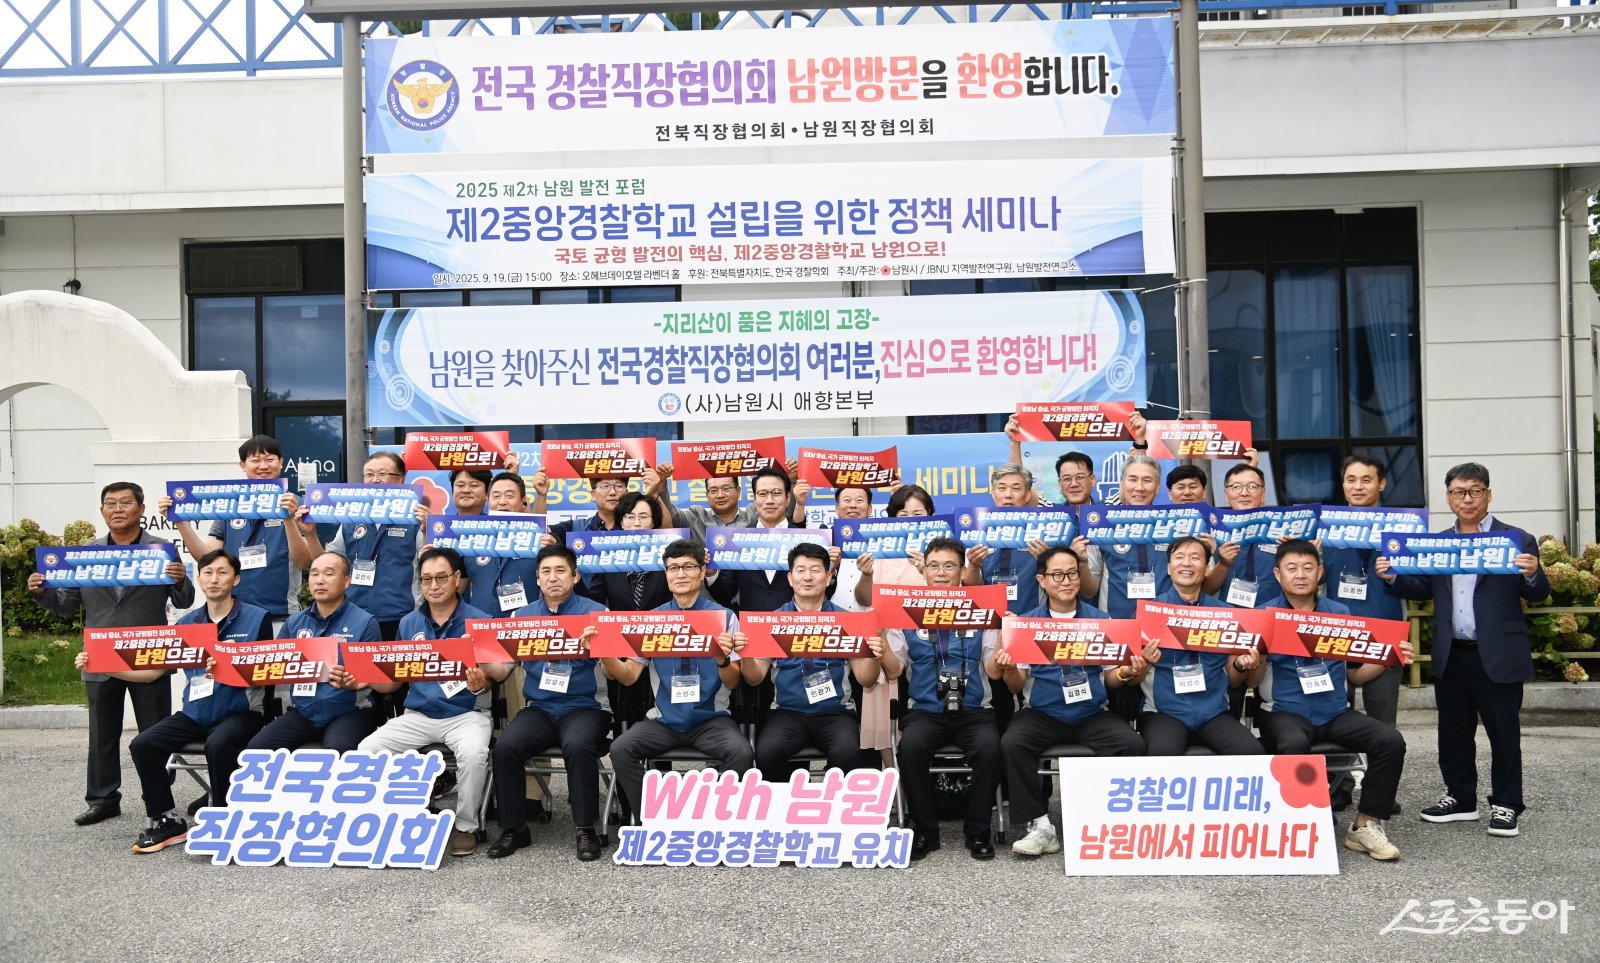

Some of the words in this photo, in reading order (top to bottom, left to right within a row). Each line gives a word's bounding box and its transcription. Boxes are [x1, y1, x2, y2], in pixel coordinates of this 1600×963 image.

[472, 66, 535, 111] 전국
[546, 59, 776, 110] 경찰직장협의회
[788, 57, 947, 102] 남원방문을
[957, 51, 1121, 99] 환영합니다.
[456, 183, 497, 197] 2025
[504, 182, 538, 197] 제2차
[544, 181, 573, 197] 남원
[580, 180, 608, 196] 발전
[616, 179, 644, 195] 포럼
[447, 203, 696, 242] 제2중앙경찰학교
[707, 201, 803, 237] 설립을
[814, 199, 879, 235] 위한
[889, 198, 951, 234] 정책
[962, 196, 1061, 232] 세미나
[555, 248, 588, 264] 국토
[594, 246, 626, 263] 균형
[633, 246, 682, 263] 발전의
[689, 245, 727, 261] 핵심,
[734, 242, 865, 260] 제2중앙경찰학교
[872, 242, 945, 258] 남원으로!
[433, 273, 453, 285] 일시:
[526, 272, 552, 281] 15:00
[560, 272, 579, 281] 장소:
[644, 270, 669, 279] 라벤더
[672, 269, 680, 279] 홀
[689, 269, 708, 279] 후원:
[711, 268, 773, 278] 전북특별자치도,
[776, 268, 792, 277] 한국
[795, 267, 828, 277] 경찰학회
[836, 264, 880, 277] 주최/주관:
[893, 265, 917, 275] 남원시
[926, 264, 950, 274] JBNU
[952, 263, 1014, 273] 지역발전연구원,
[1016, 261, 1078, 273] 남원발전연구소
[654, 312, 731, 334] -지리산이
[738, 311, 772, 332] 품은
[779, 310, 829, 331] 지혜의
[837, 309, 879, 330] 고장-
[430, 350, 495, 388] 남원을
[502, 348, 589, 387] 찾아주신
[598, 342, 800, 385] 전국경찰직장협의회
[977, 334, 1098, 377] 환영합니다!
[686, 393, 782, 413] (사)남원시
[794, 391, 873, 410] 애향본부
[1060, 422, 1123, 437] 남원으로!
[1178, 440, 1241, 455] 남원으로!
[440, 452, 498, 466] 남원으로!
[584, 458, 644, 474] 남원으로!
[716, 458, 776, 474] 남원으로!
[836, 468, 894, 484] 남원으로!
[175, 502, 198, 514] 남원!
[200, 498, 236, 514] 남원!
[238, 494, 282, 514] 남원!
[310, 505, 333, 516] 남원!
[334, 502, 369, 517] 남원!
[370, 498, 417, 518] 남원!
[139, 516, 200, 530] BAKY
[960, 530, 984, 540] 남원!
[986, 526, 1022, 541] 남원!
[1024, 522, 1071, 542] 남원!
[1086, 528, 1112, 538] 남원!
[1114, 524, 1152, 538] 남원!
[1152, 518, 1202, 538] 남원!
[1231, 524, 1266, 541] 남원!
[1267, 518, 1316, 539] 남원!
[458, 534, 493, 550] 남원!
[495, 532, 542, 552] 남원!
[1328, 525, 1368, 542] 남원!
[842, 542, 864, 552] 남원!
[867, 536, 904, 552] 남원!
[599, 550, 636, 566] 남원!
[713, 550, 738, 562] 남원!
[740, 547, 776, 564] 남원!
[1390, 556, 1414, 566] 남원!
[1417, 552, 1456, 568] 남원!
[1460, 548, 1516, 568] 남원!
[46, 570, 72, 580] 남원!
[75, 564, 114, 580] 남원!
[116, 560, 170, 579] 남원!
[902, 598, 972, 608] 제2중앙경찰학교
[922, 608, 994, 624] 남원으로!
[1166, 616, 1240, 630] 제2중앙경찰학교
[496, 628, 564, 640] 제2중앙경찰학교
[621, 624, 690, 634] 제2중앙경찰학교
[770, 625, 842, 634] 제2중앙경찰학교
[1034, 632, 1106, 642] 제2중앙경찰학교
[1296, 624, 1372, 640] 제2중앙경찰학교
[114, 638, 183, 650] 제2중앙경찰학교
[641, 635, 712, 652] 남원으로!
[791, 636, 863, 653] 남원으로!
[1186, 629, 1261, 650] 남원으로!
[1315, 636, 1392, 660] 남원으로!
[134, 647, 205, 666] 남원으로!
[231, 651, 302, 664] 제2중앙경찰학교
[372, 652, 440, 662] 제2중앙경찰학교
[1054, 642, 1128, 660] 남원으로!
[252, 661, 324, 681] 남원으로!
[394, 661, 462, 678] 남원으로!
[229, 752, 443, 806] 전국경찰
[643, 771, 773, 821] With
[785, 771, 896, 826] 남원
[1108, 777, 1196, 812] 경찰의
[1204, 776, 1270, 814] 미래,
[188, 809, 452, 867] 직장협의회
[616, 829, 842, 865] 제2중앙경찰학교
[851, 830, 911, 865] 유치
[1080, 824, 1194, 859] 남원에서
[1200, 823, 1318, 859] 피어나다
